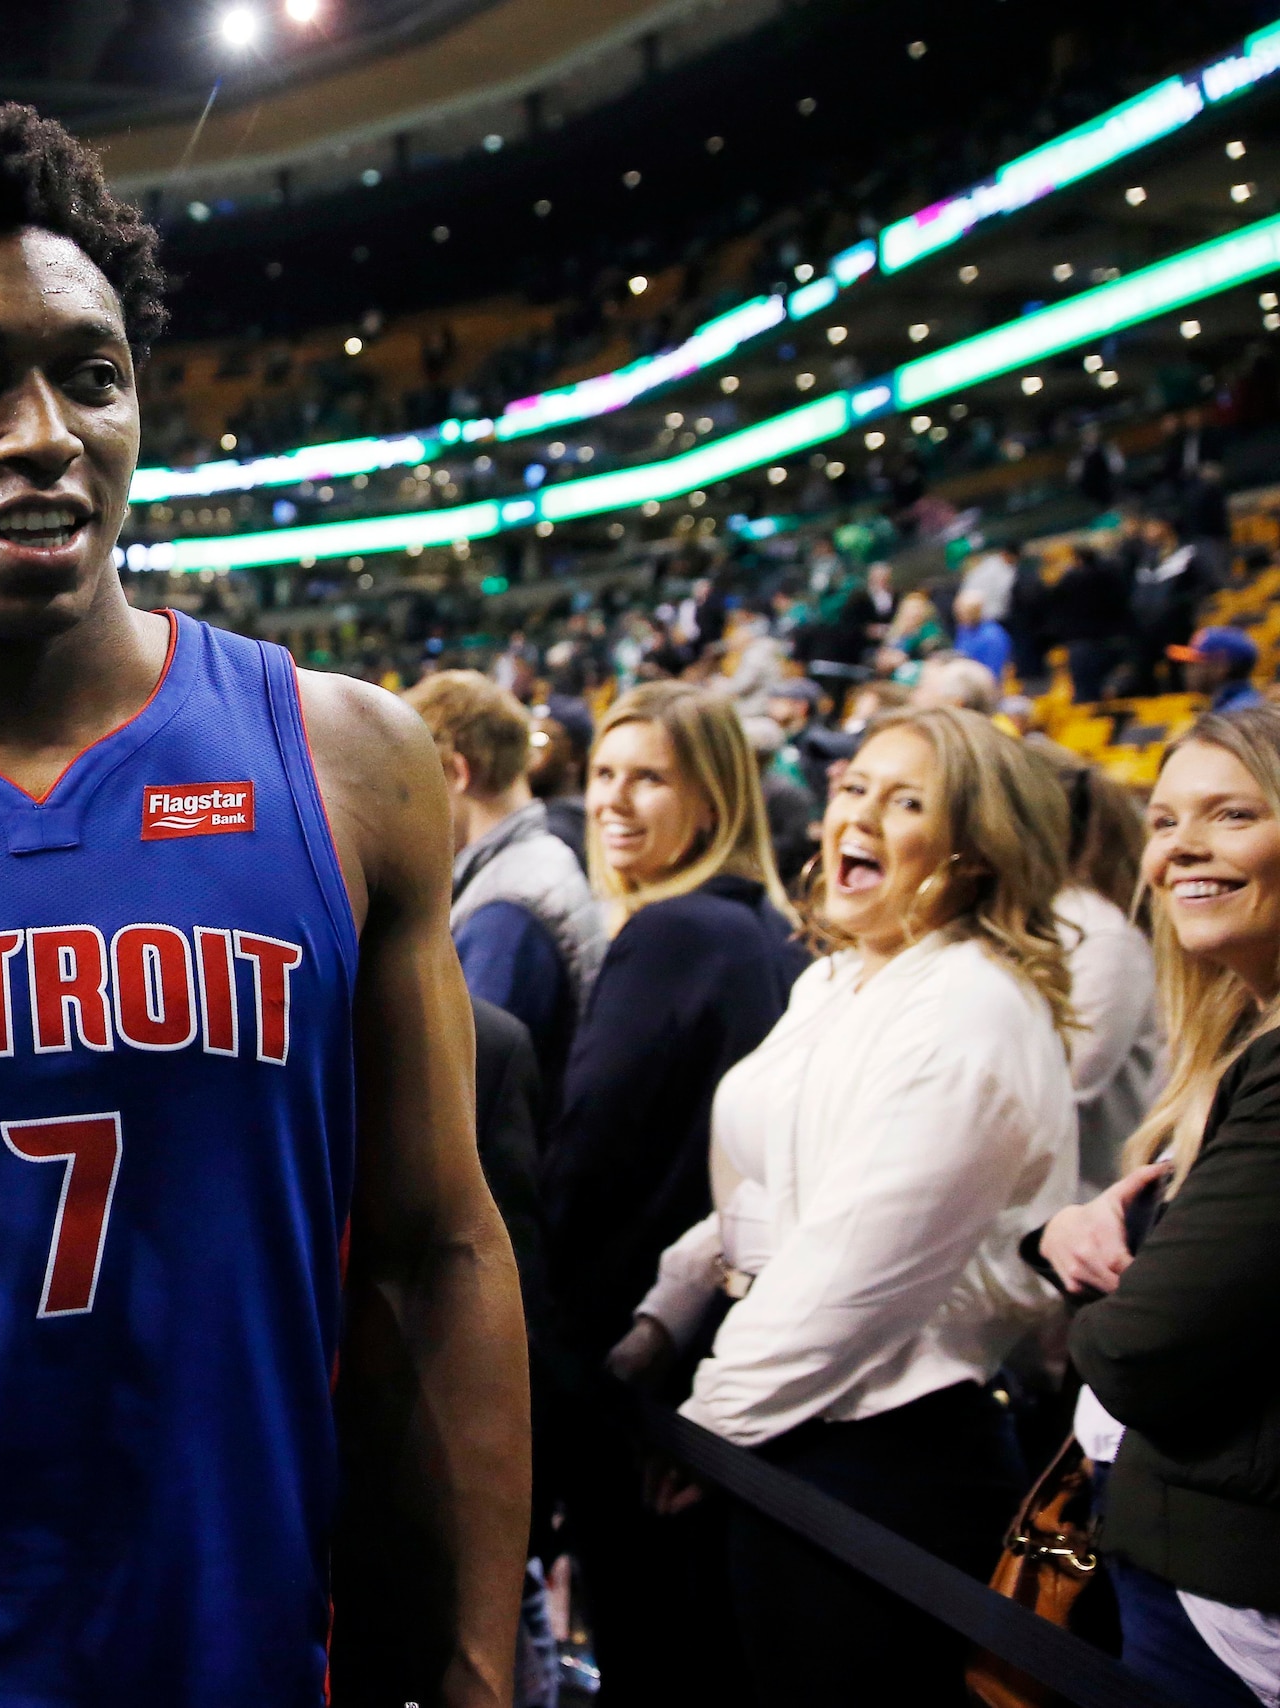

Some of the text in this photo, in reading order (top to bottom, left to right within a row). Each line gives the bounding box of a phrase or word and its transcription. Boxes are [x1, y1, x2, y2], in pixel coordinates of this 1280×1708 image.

[149, 790, 247, 815] Flagstar
[211, 813, 246, 825] Bank
[0, 1111, 123, 1319] 7
